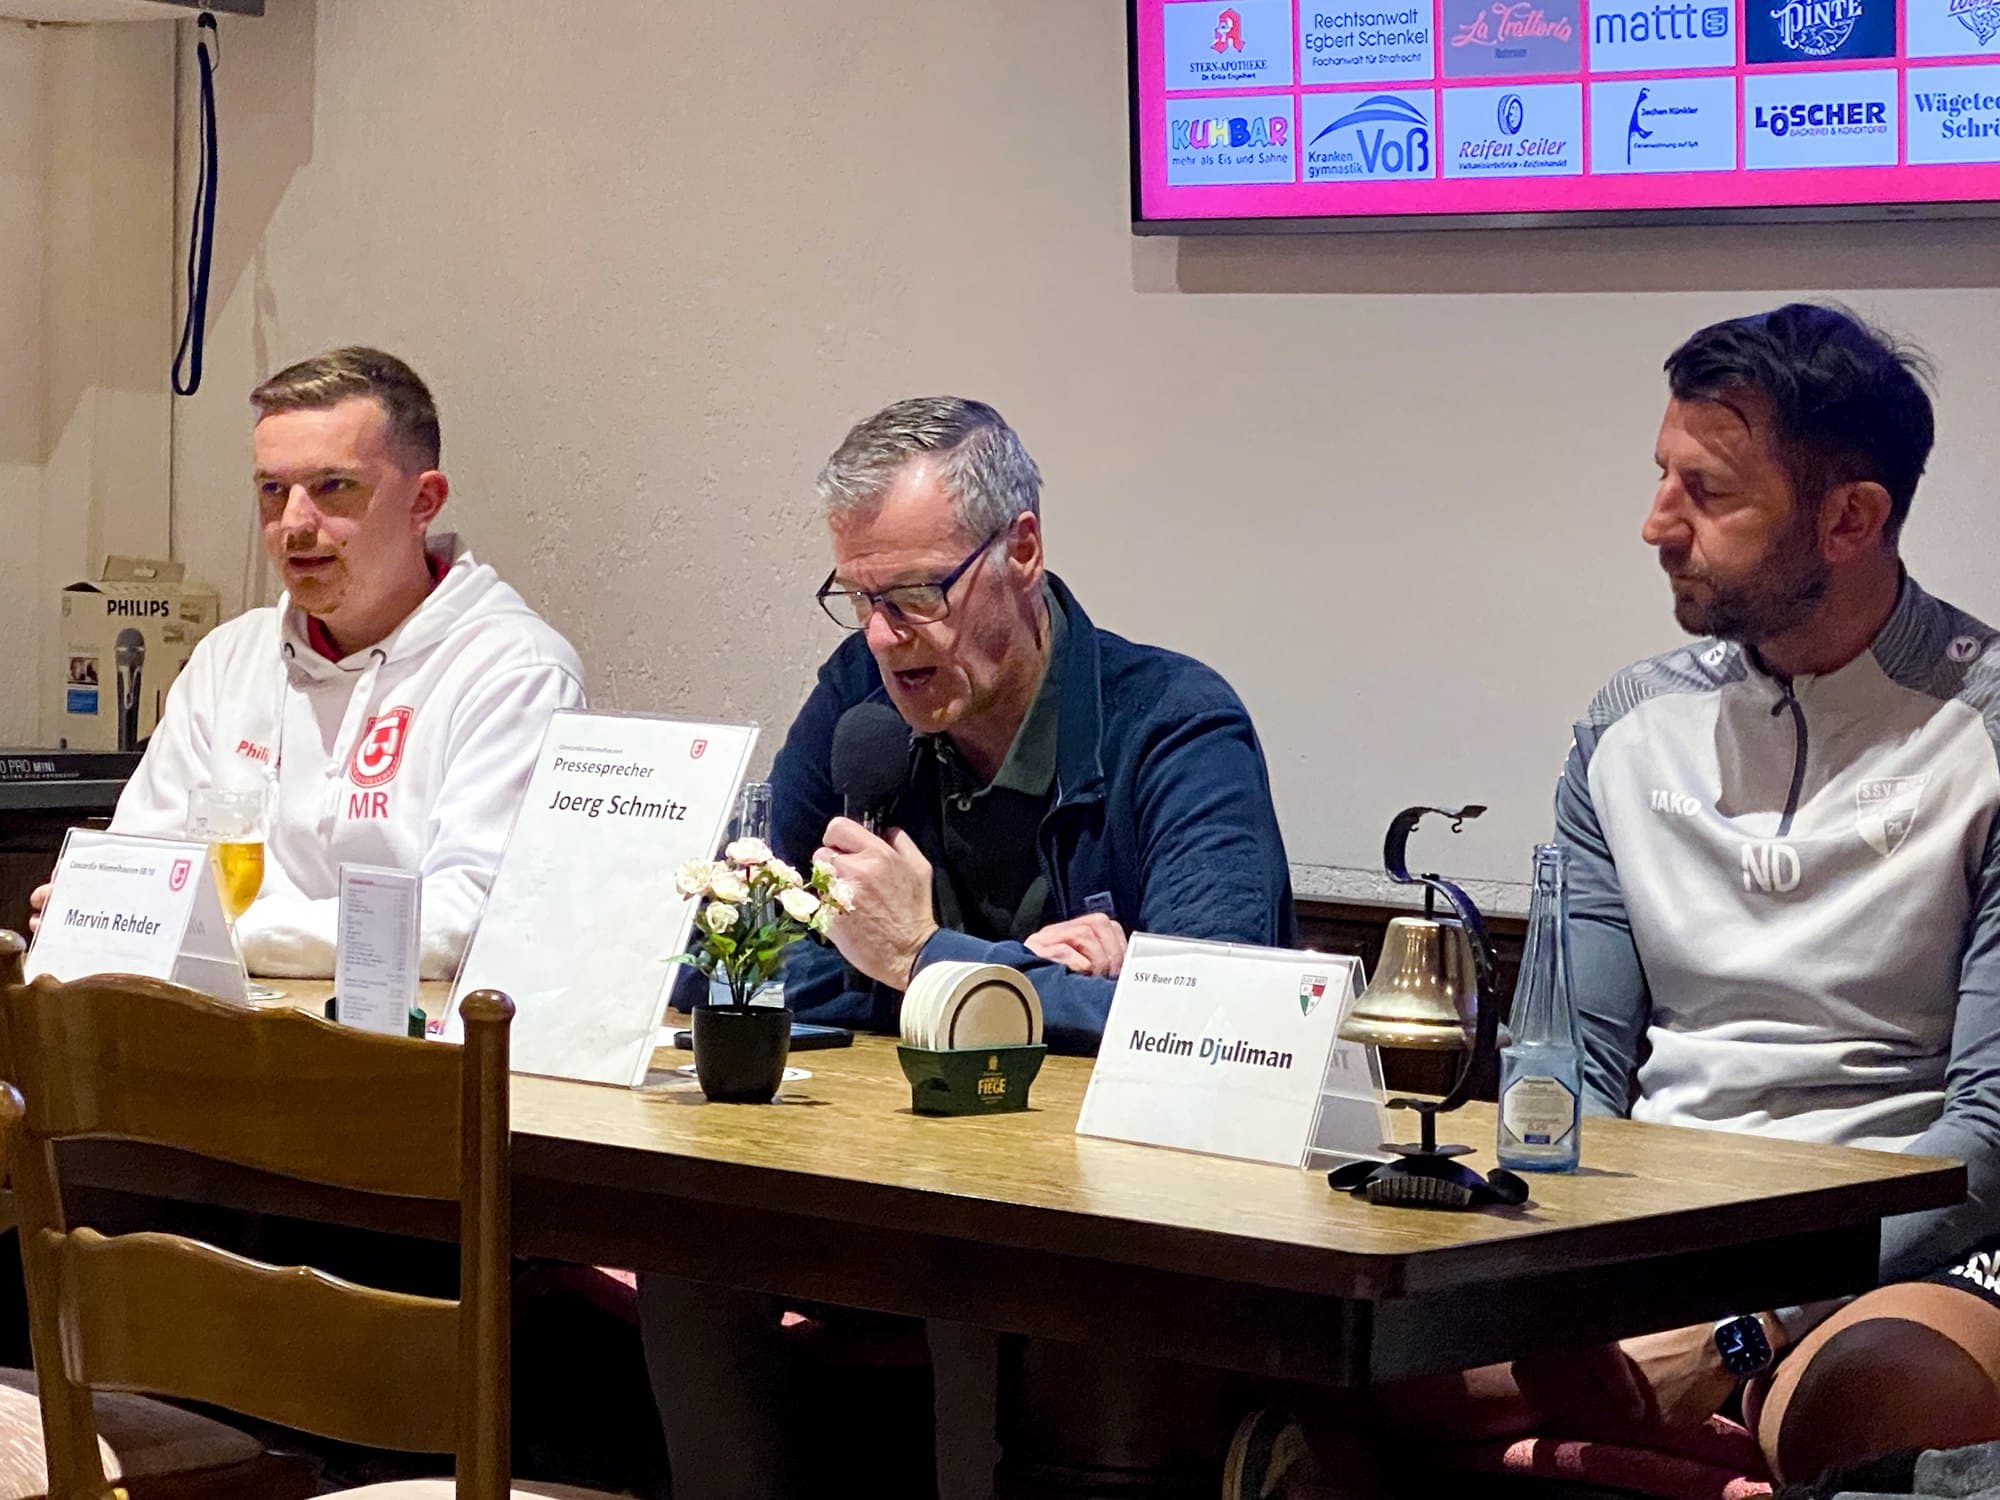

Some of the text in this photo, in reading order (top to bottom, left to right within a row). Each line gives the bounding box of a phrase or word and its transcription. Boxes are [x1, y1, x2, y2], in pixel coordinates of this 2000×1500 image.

[1314, 9, 1418, 30] Rechtsanwalt
[1451, 2, 1572, 46] La Trattoria
[1305, 29, 1428, 52] Egbert Schenkel
[1189, 59, 1268, 72] STERN-APOTHEKE
[1312, 53, 1422, 66] Fachanwalt für Strafrecht
[1755, 102, 1887, 137] LÖSCHER
[1171, 116, 1288, 150] KUHBAR
[1830, 126, 1836, 135] &
[1172, 152, 1288, 165] mehr als Eis und Sahne
[1308, 151, 1353, 163] Kranken
[1356, 127, 1429, 173] Voß
[1459, 137, 1566, 161] Reifen Seiler
[1308, 163, 1363, 177] gymnastik
[107, 599, 170, 617] PHILIPS
[8, 759, 31, 773] PRO
[33, 761, 55, 773] MINI
[553, 757, 655, 778] Pressesprecher
[347, 792, 389, 820] MR
[549, 791, 687, 821] Joerg Schmitz
[1741, 842, 1801, 893] ND
[65, 909, 110, 931] Marvin
[112, 913, 161, 936] Rehder
[1133, 971, 1151, 982] SSV
[1152, 973, 1172, 984] Buer
[1129, 1029, 1293, 1070] Nedim Djuliman
[978, 1077, 1007, 1095] FIEGE
